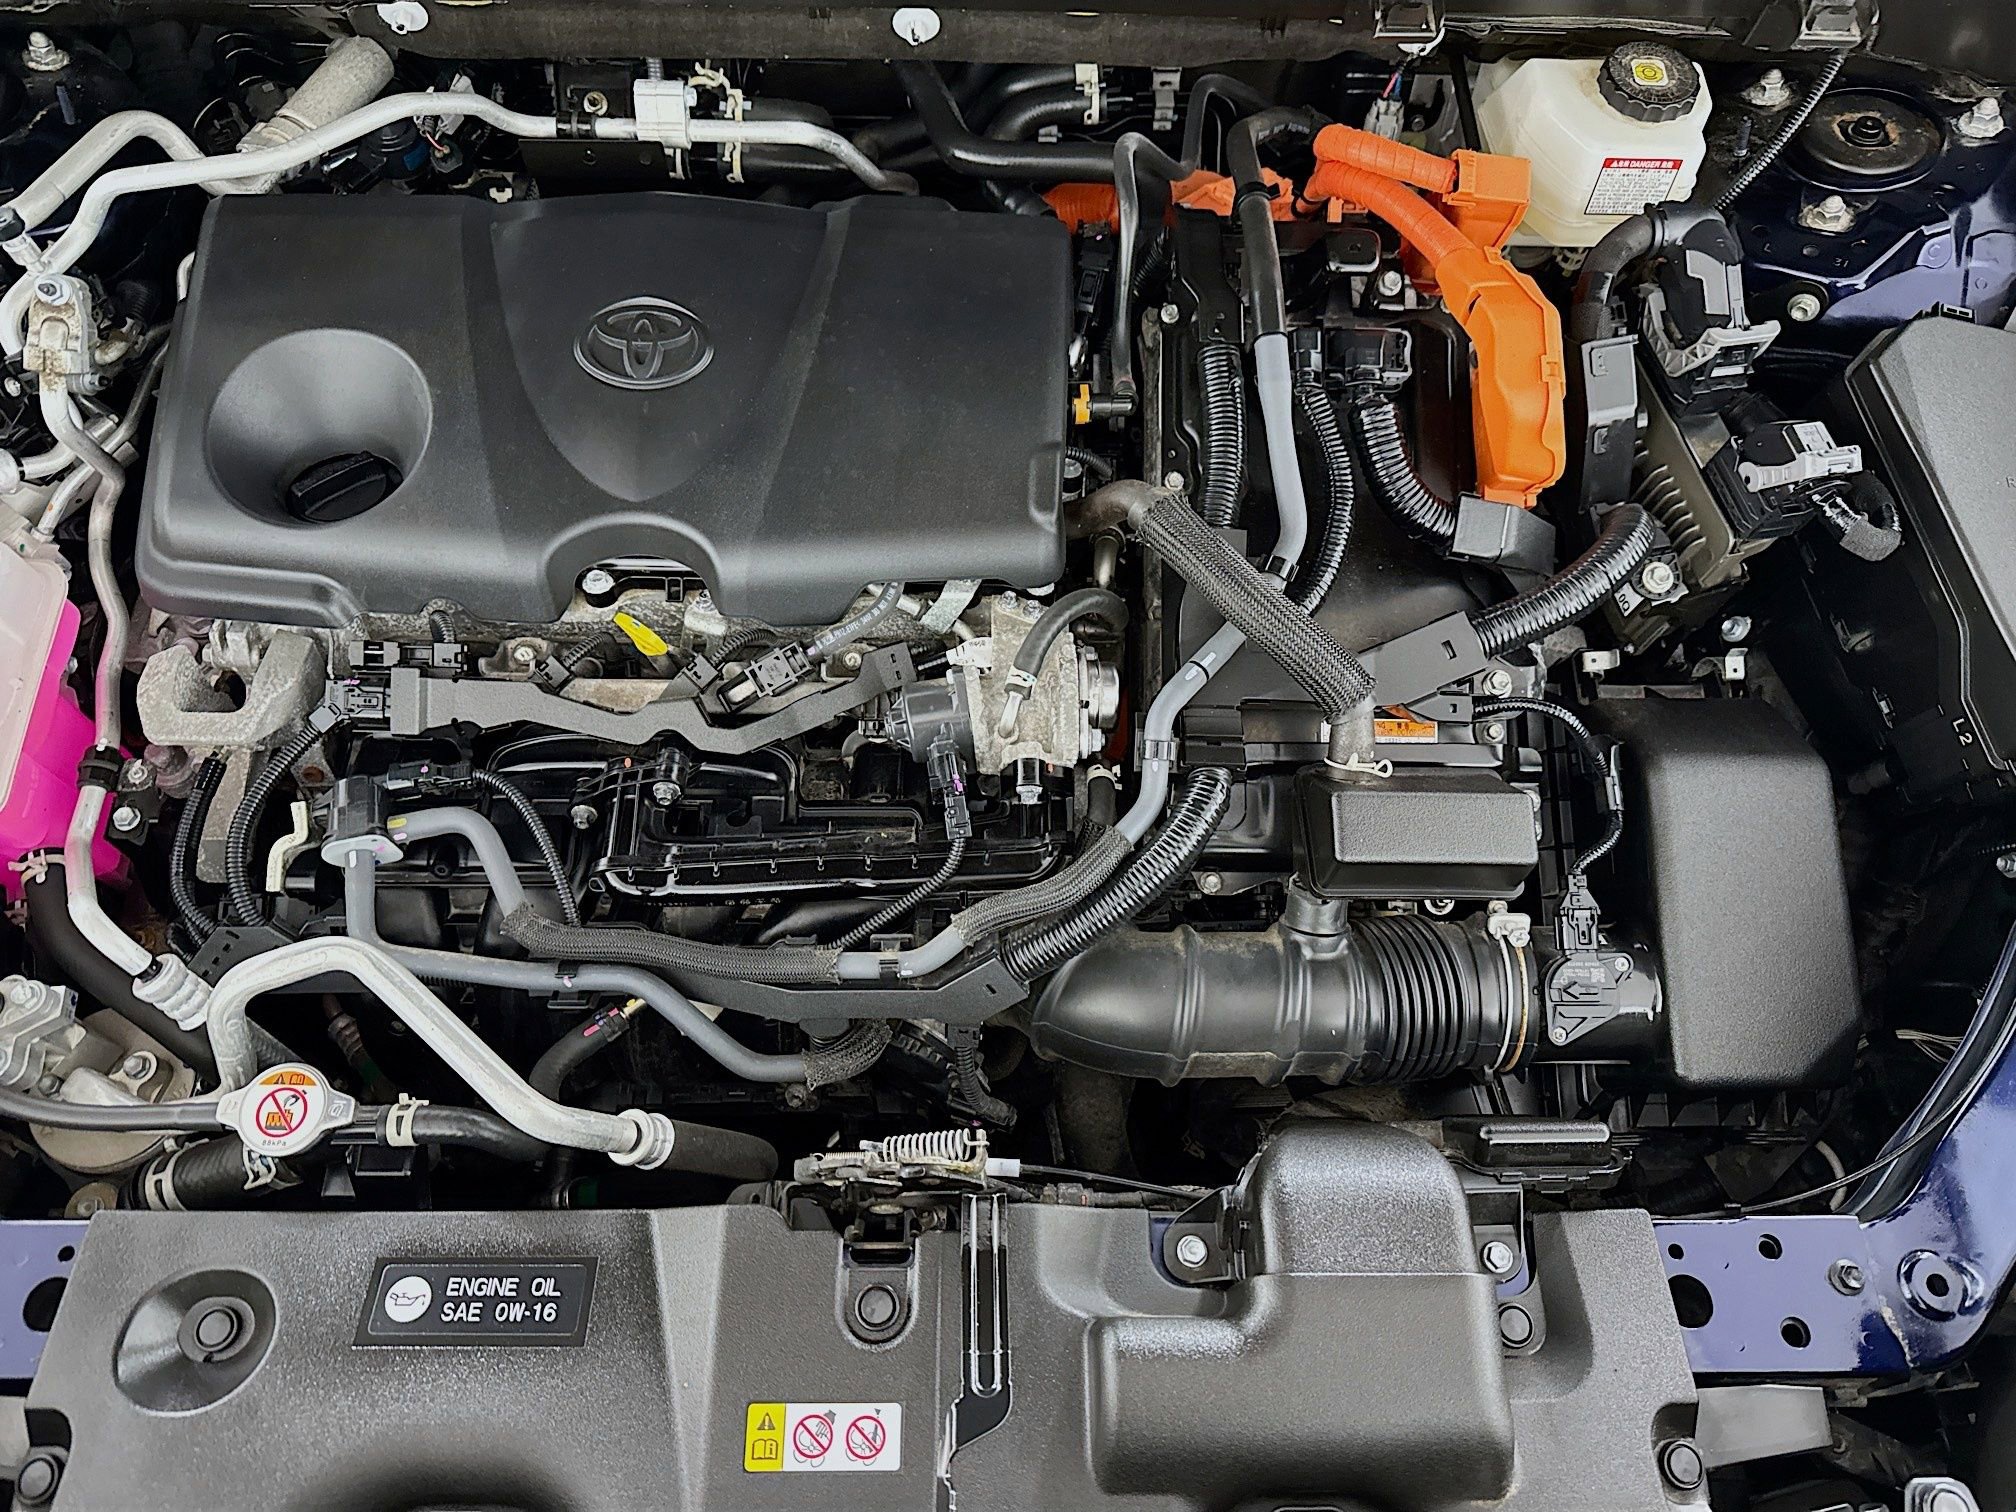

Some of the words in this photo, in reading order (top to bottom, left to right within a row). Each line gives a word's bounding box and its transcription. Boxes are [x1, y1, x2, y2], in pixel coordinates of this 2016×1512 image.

[1630, 160, 1662, 169] DANGER
[1952, 717, 1973, 746] L2
[445, 1276, 520, 1297] ENGINE
[531, 1276, 562, 1298] OIL
[440, 1301, 484, 1322] SAE
[494, 1301, 558, 1322] 0W-16
